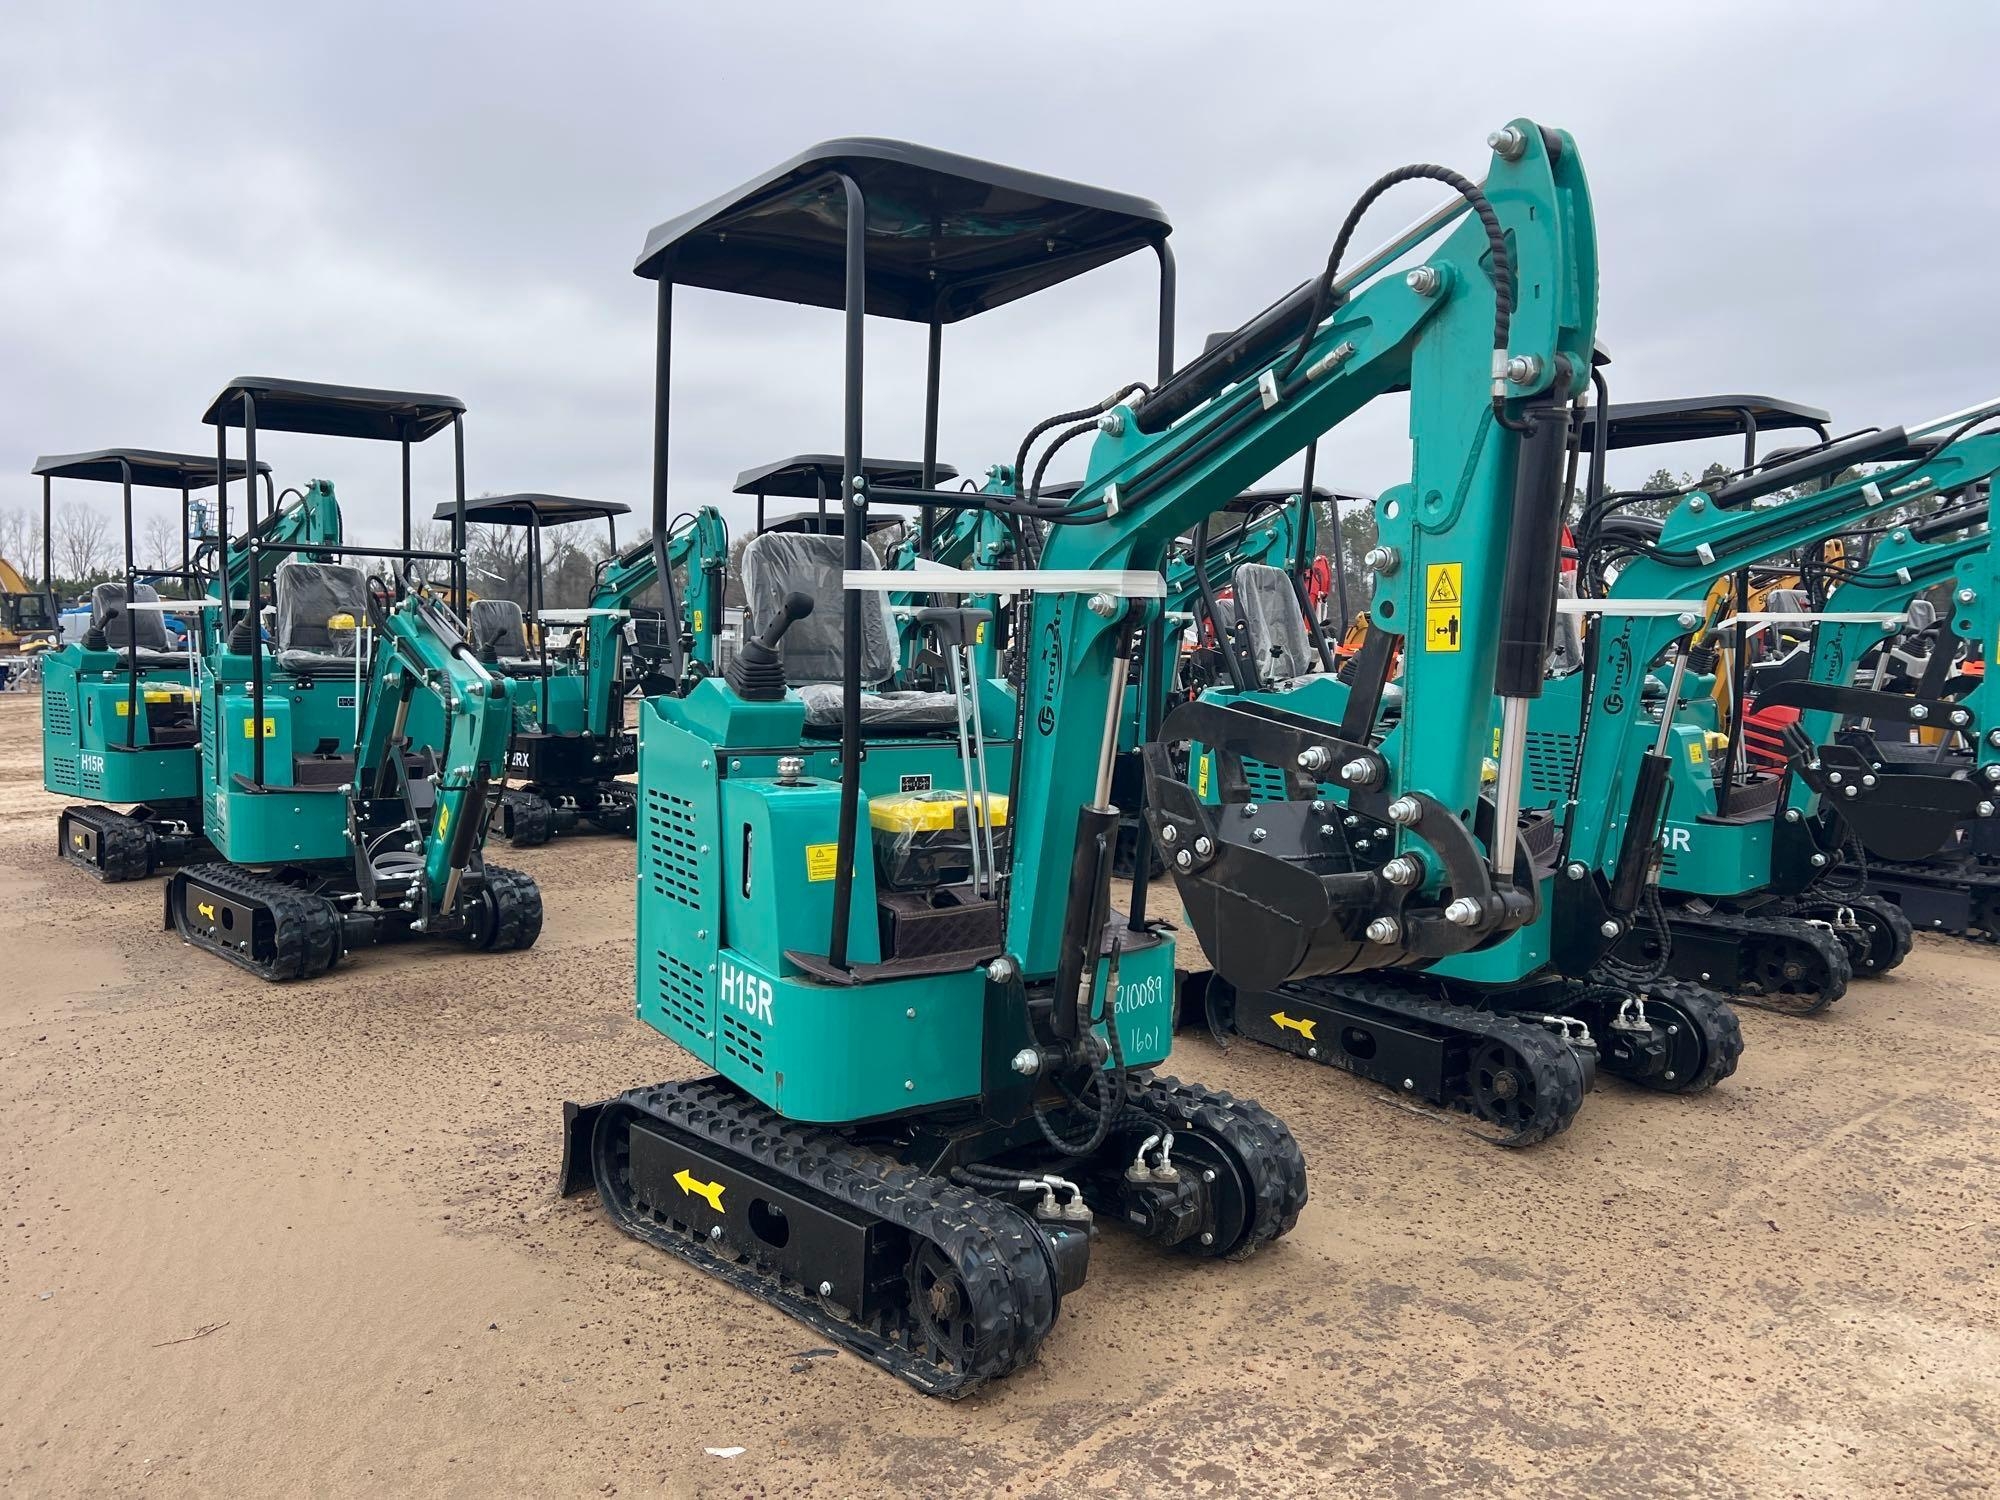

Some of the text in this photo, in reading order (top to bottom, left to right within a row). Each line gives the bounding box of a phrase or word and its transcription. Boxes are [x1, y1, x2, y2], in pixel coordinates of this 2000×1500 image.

[81, 754, 105, 773] H15R
[721, 961, 774, 1027] H15R
[1114, 976, 1163, 1014] 210089
[1131, 1026, 1159, 1053] 1601
